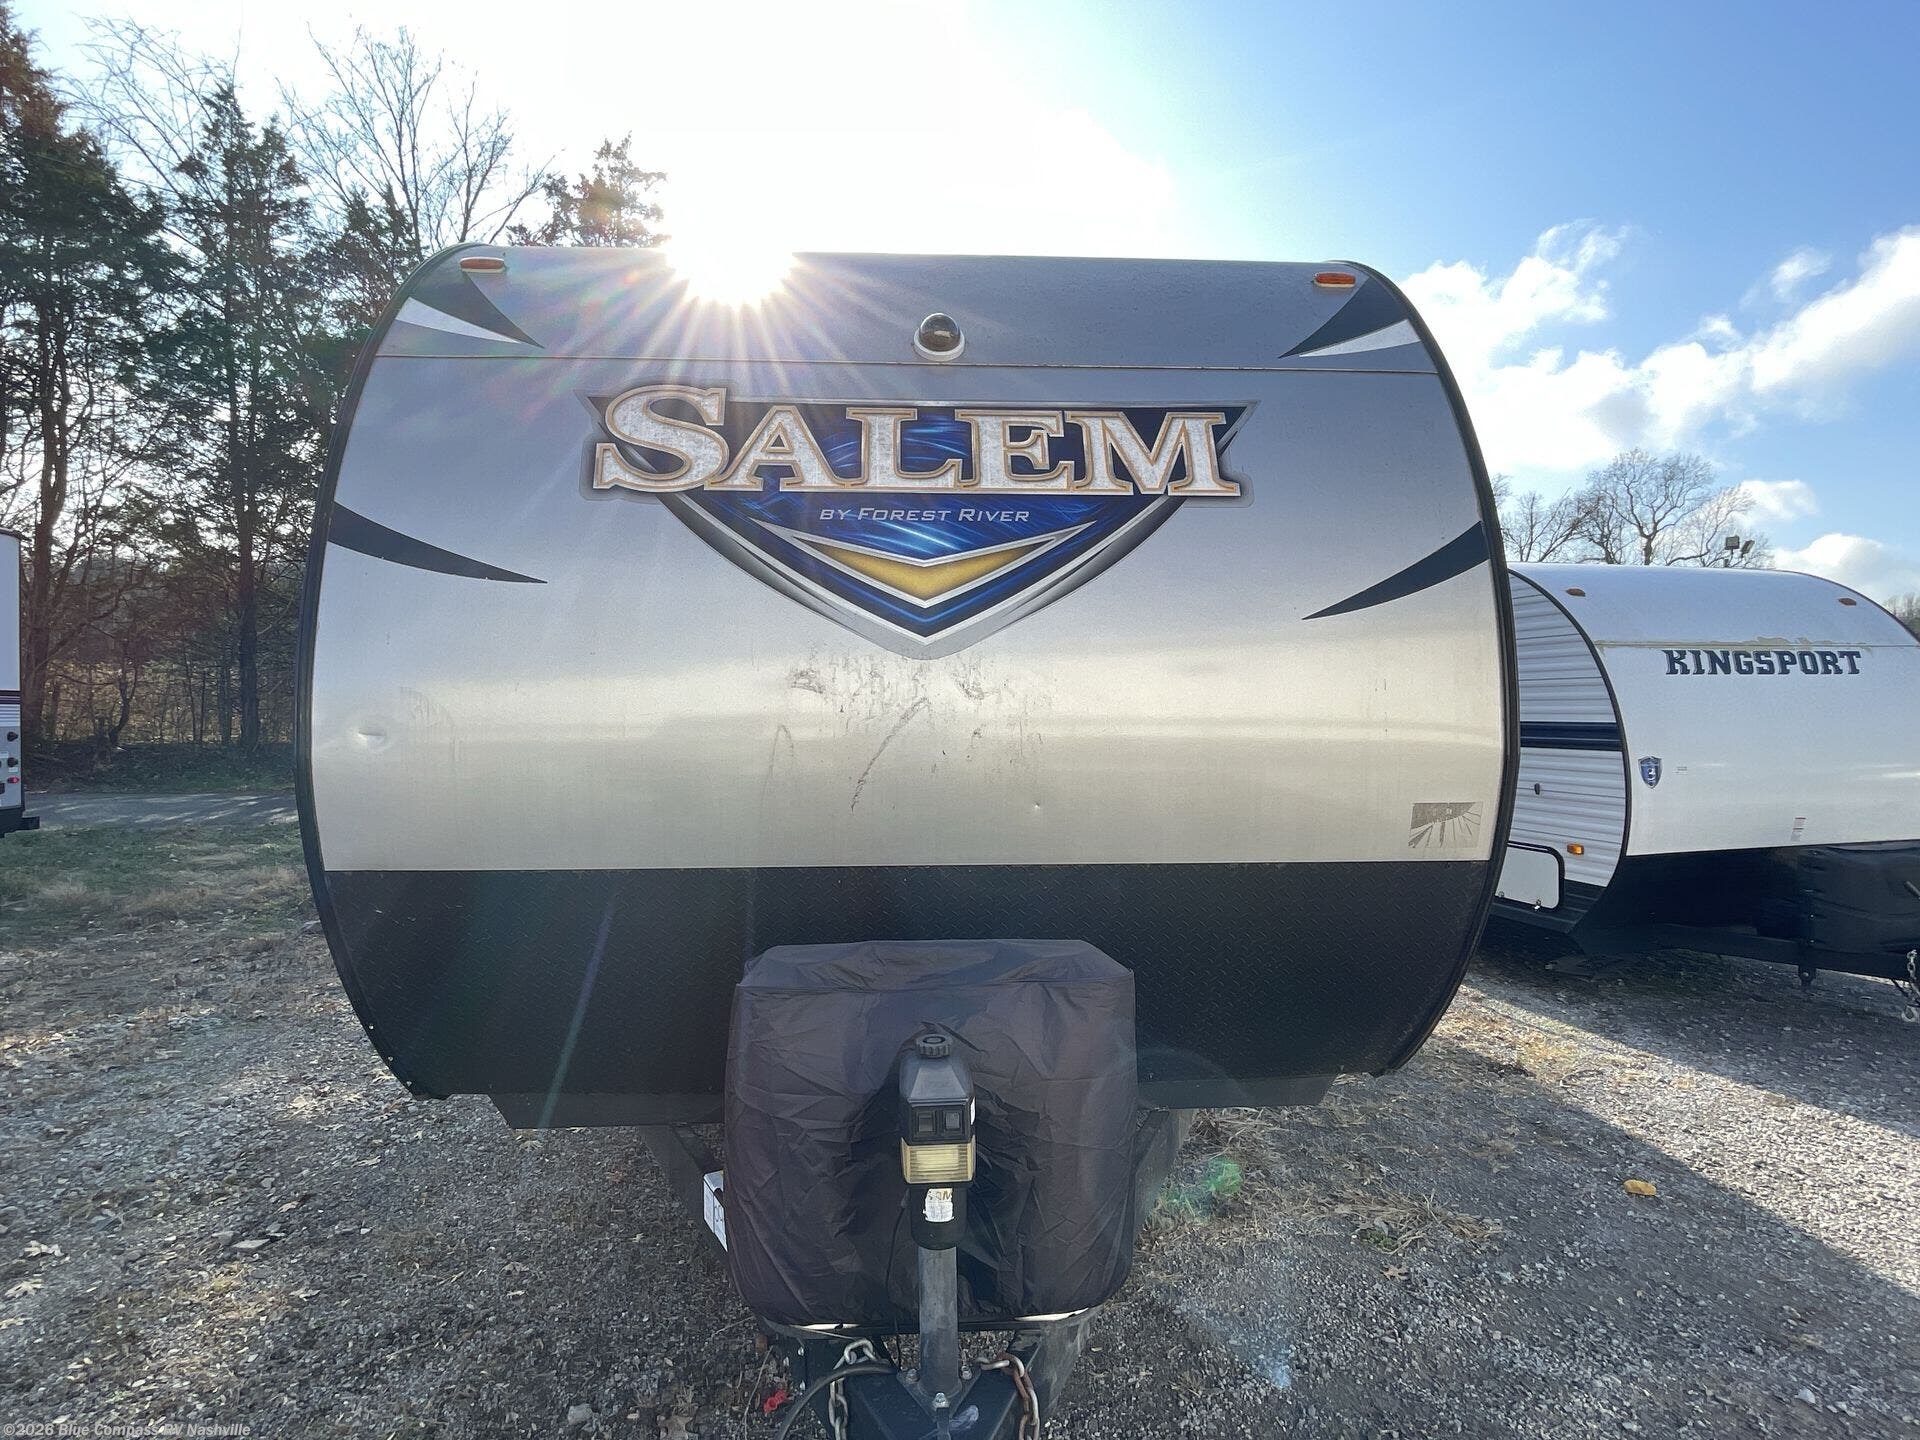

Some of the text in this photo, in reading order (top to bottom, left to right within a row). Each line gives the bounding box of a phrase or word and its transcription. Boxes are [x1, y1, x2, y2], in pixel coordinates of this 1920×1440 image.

[592, 385, 1241, 497] SALEM
[819, 507, 1030, 522] BY FOREST RIVER
[1662, 650, 1862, 675] KINGSPORT
